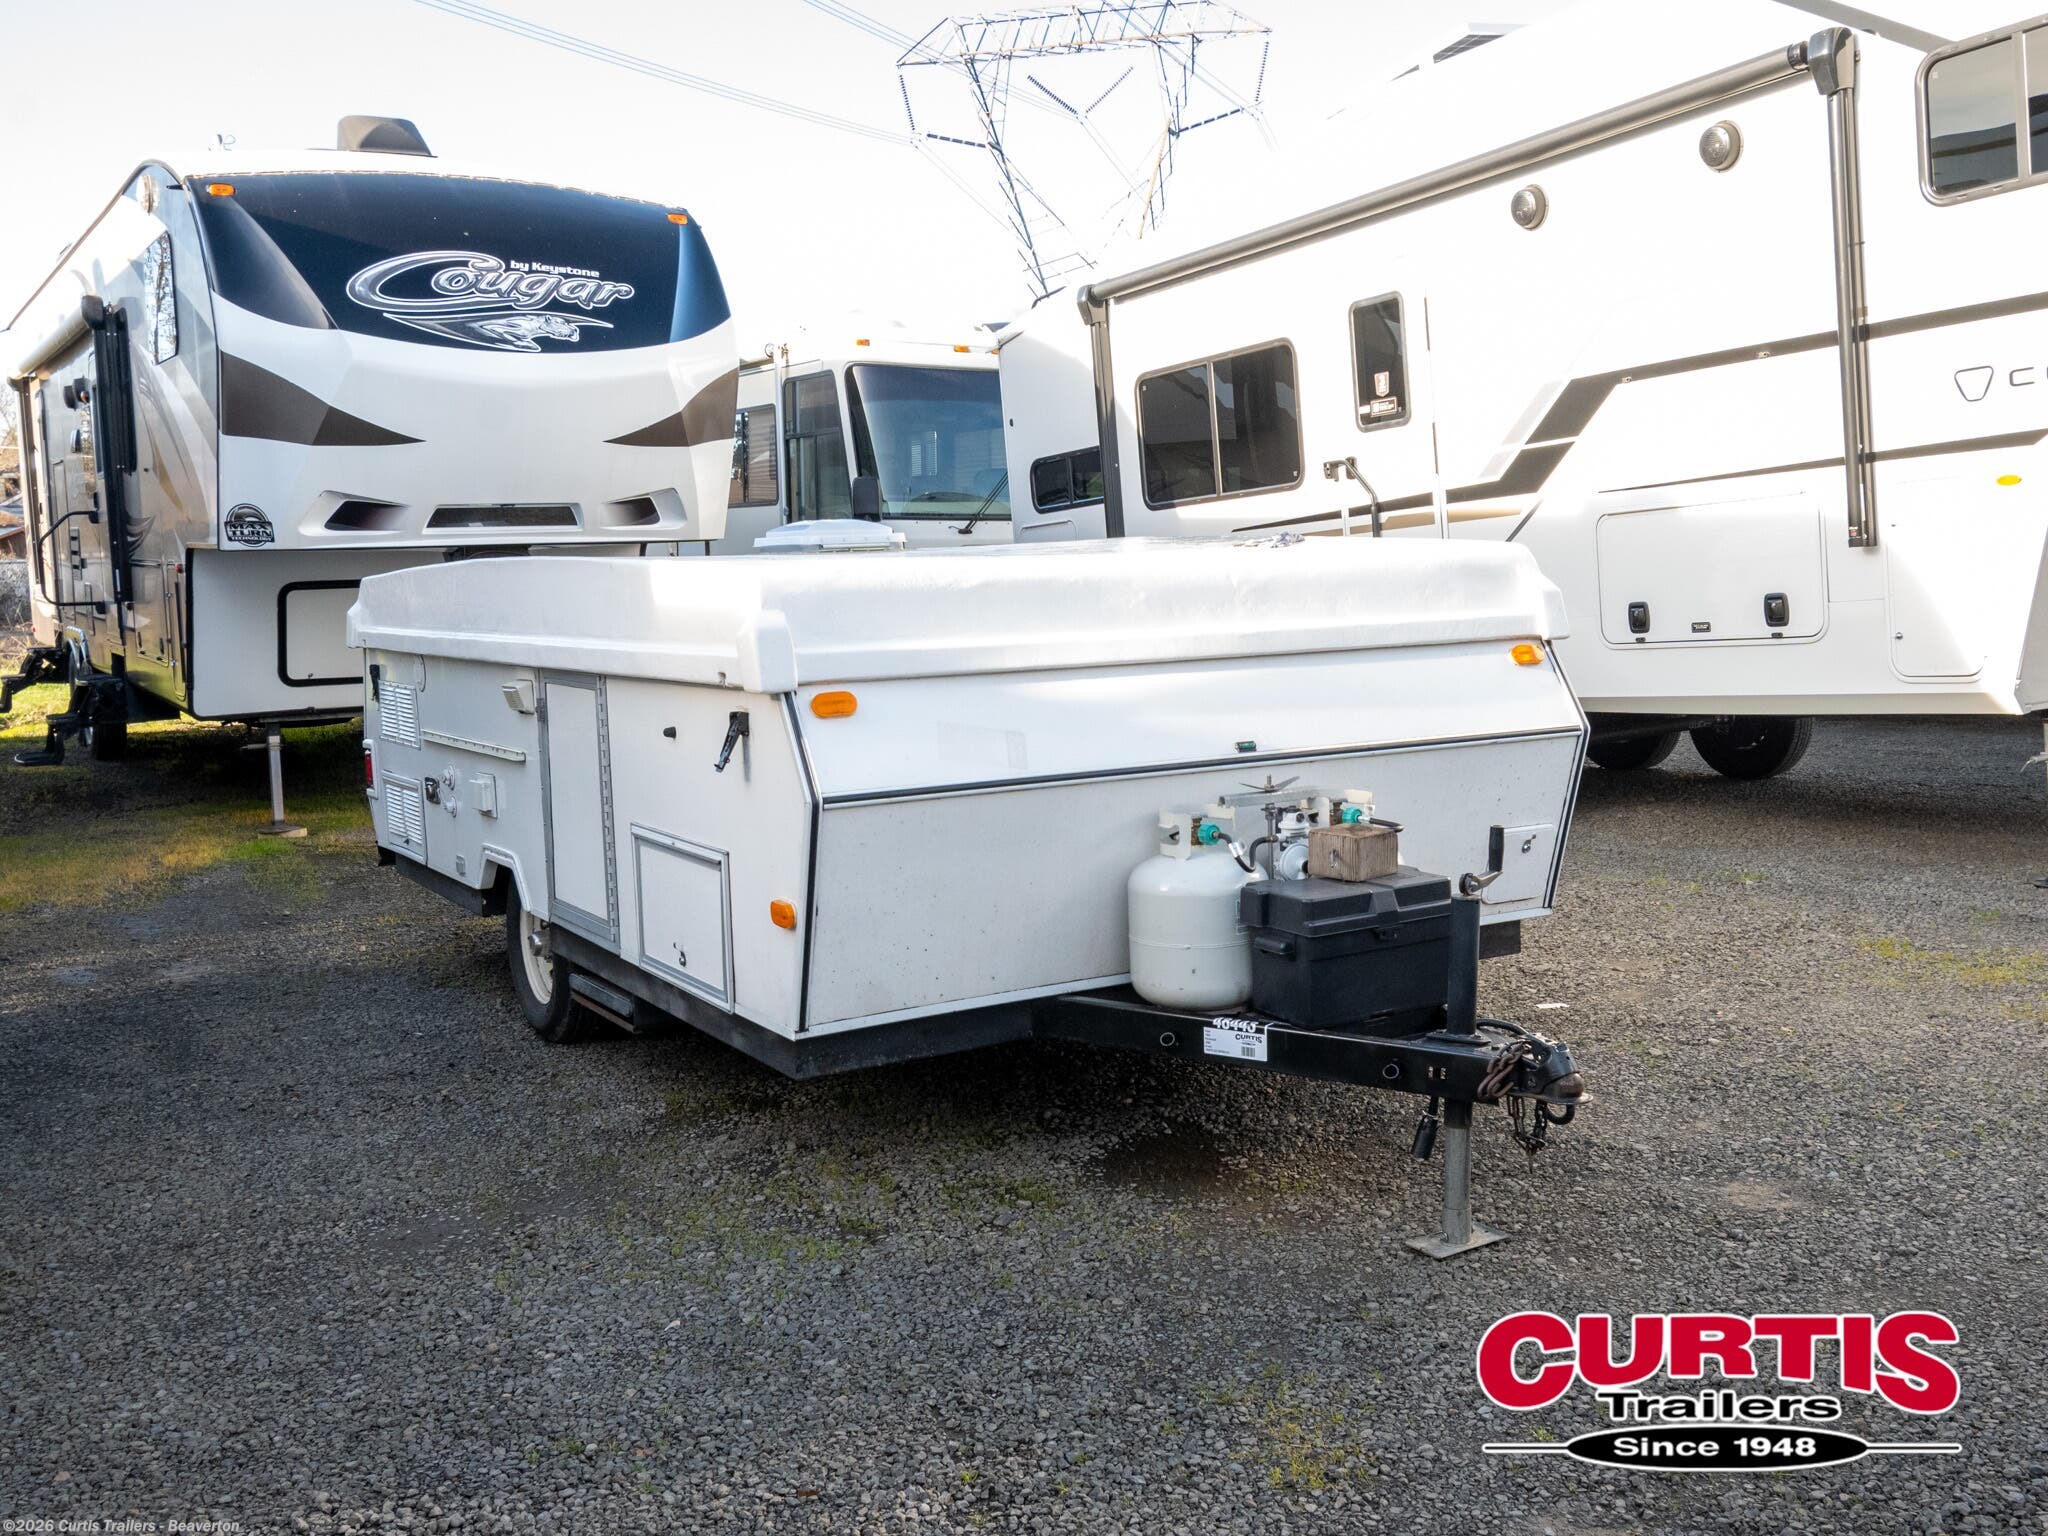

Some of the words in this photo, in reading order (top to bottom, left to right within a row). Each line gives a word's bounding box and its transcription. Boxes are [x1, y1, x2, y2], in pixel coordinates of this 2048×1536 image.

[510, 259, 530, 272] by
[532, 261, 600, 278] Keystone
[346, 251, 635, 312] Cougar
[1234, 1033, 1263, 1044] CURTIS
